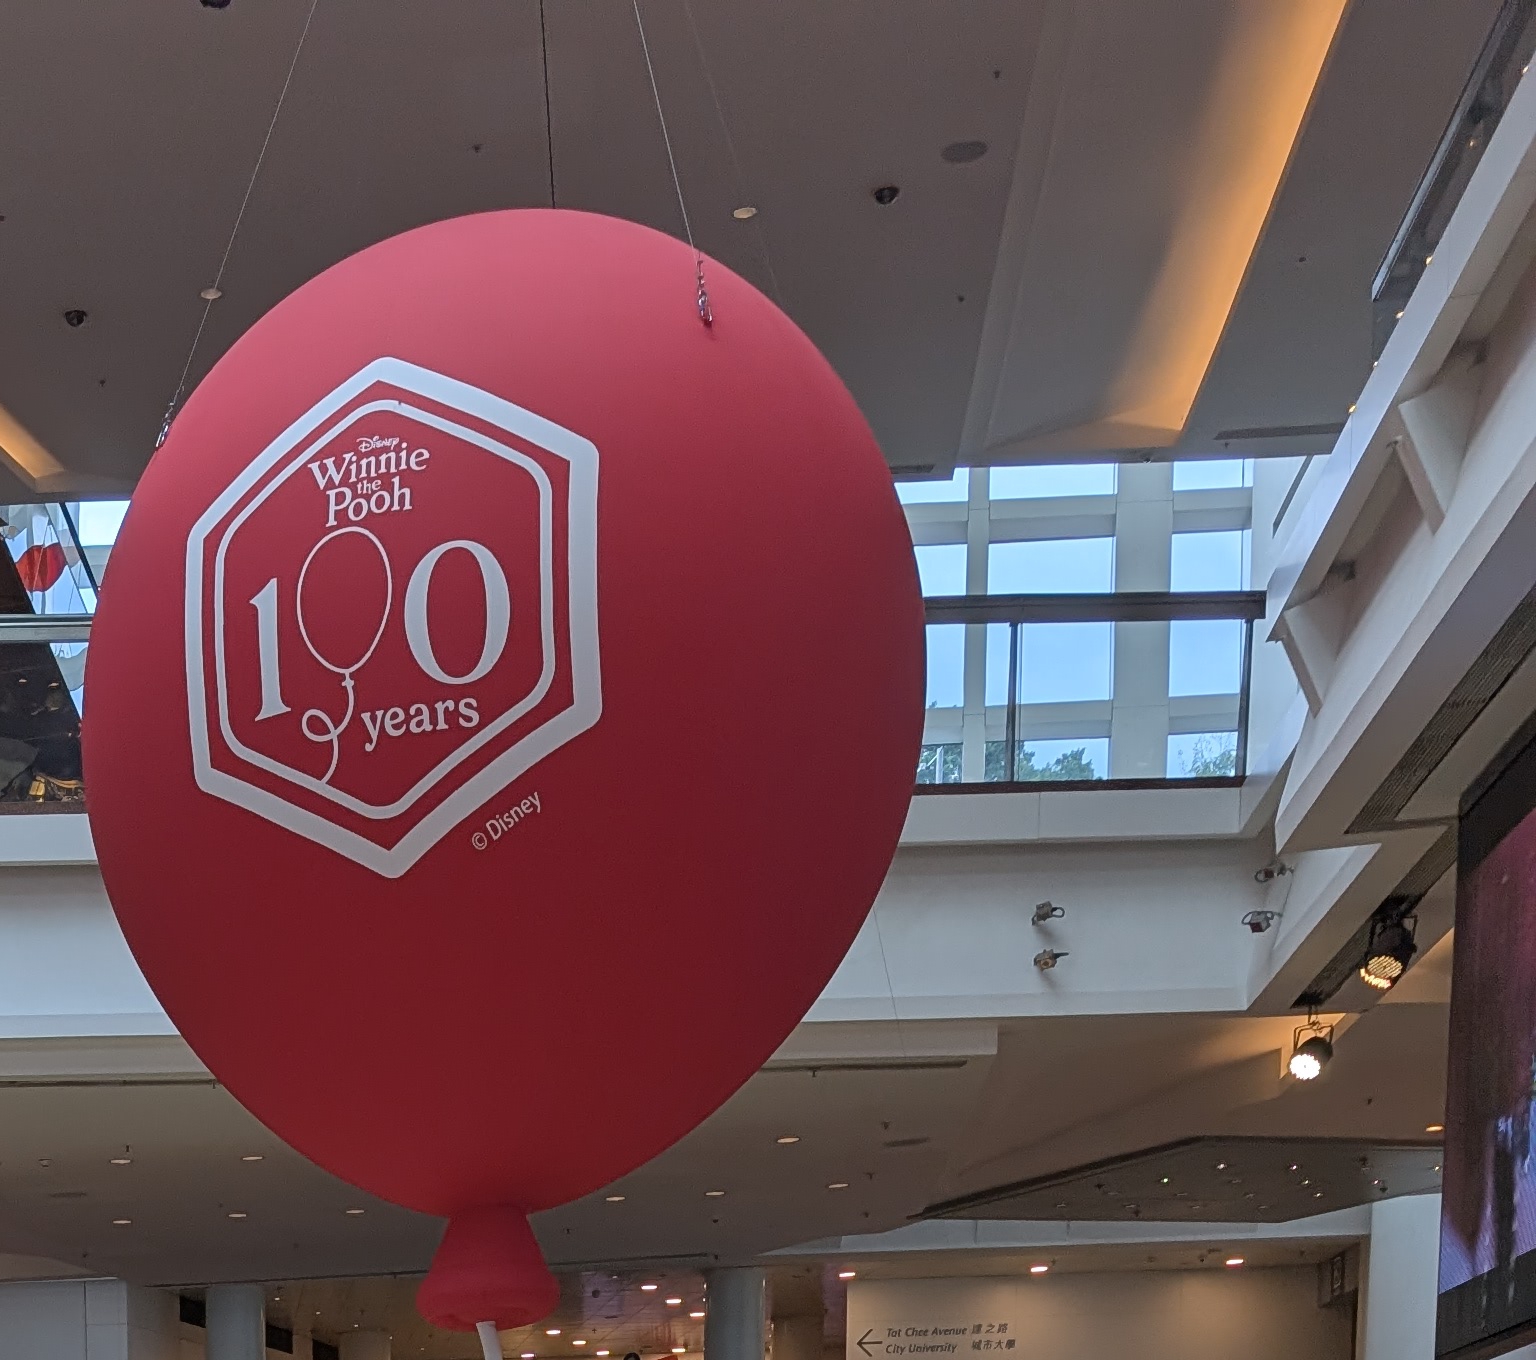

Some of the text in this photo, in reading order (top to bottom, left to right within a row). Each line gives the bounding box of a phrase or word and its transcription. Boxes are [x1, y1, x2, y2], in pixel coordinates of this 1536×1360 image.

[356, 435, 400, 453] Disney
[307, 442, 430, 490] Winnie
[325, 476, 413, 528] Pooh
[356, 479, 382, 495] the
[360, 696, 480, 752] years
[485, 790, 543, 843] Disney
[886, 1326, 967, 1338] Tat Chee Avenue
[885, 1342, 957, 1356] City University
